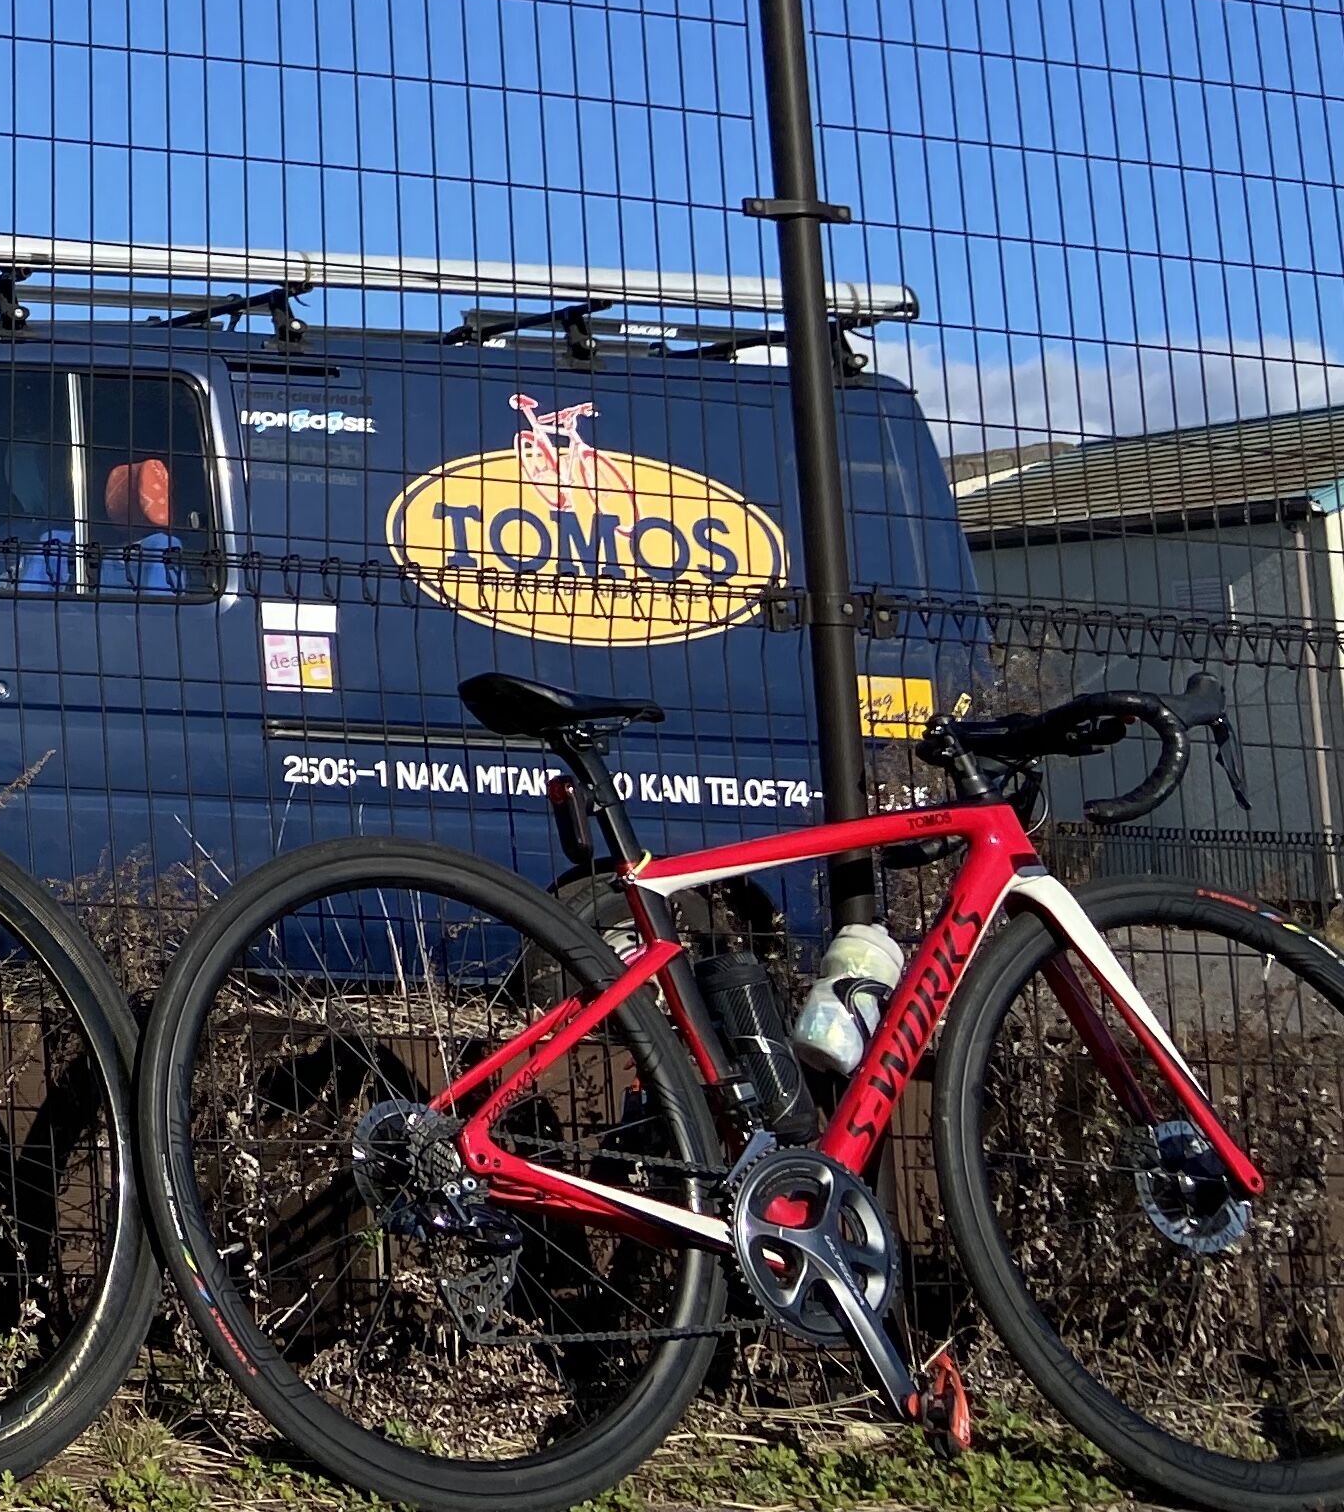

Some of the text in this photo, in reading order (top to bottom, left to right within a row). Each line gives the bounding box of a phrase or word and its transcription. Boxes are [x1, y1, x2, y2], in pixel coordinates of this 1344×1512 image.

[433, 502, 739, 583] TOMOS
[270, 651, 326, 669] dealer
[283, 755, 389, 787] 2505-1
[396, 760, 469, 793] NAKA
[640, 772, 701, 805] KANI
[906, 811, 953, 830] TOMOS
[846, 892, 984, 1145] S-WORKS
[479, 1058, 542, 1124] TARMAC
[823, 1234, 865, 1306] ULTEGRA
